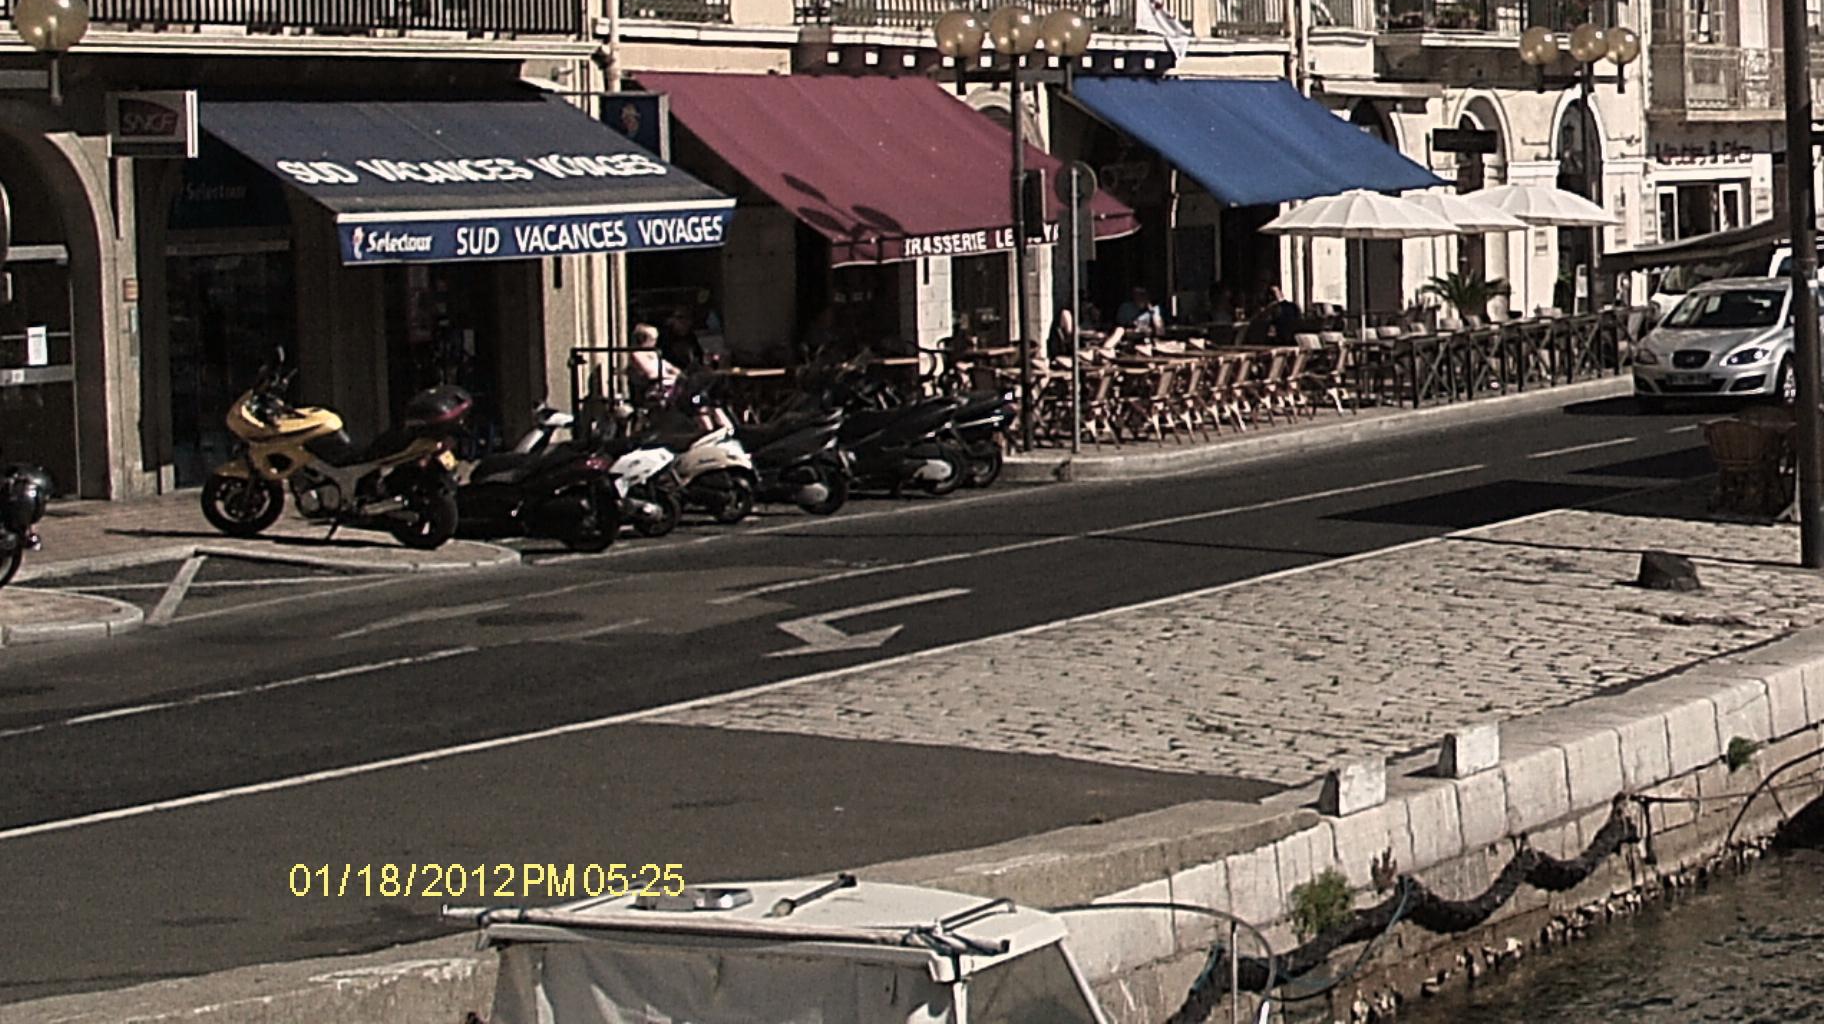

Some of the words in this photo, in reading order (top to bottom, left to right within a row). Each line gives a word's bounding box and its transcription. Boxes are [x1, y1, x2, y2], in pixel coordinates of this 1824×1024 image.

[121, 112, 175, 131] SNCF
[276, 160, 359, 184] SUD
[355, 158, 534, 183] VACANCES
[528, 154, 667, 178] VOYAGES
[366, 231, 434, 253] Selectour
[456, 227, 500, 256] SUD
[514, 220, 628, 253] VACANCES
[637, 215, 724, 245] VOYAGES
[995, 228, 1015, 248] LE
